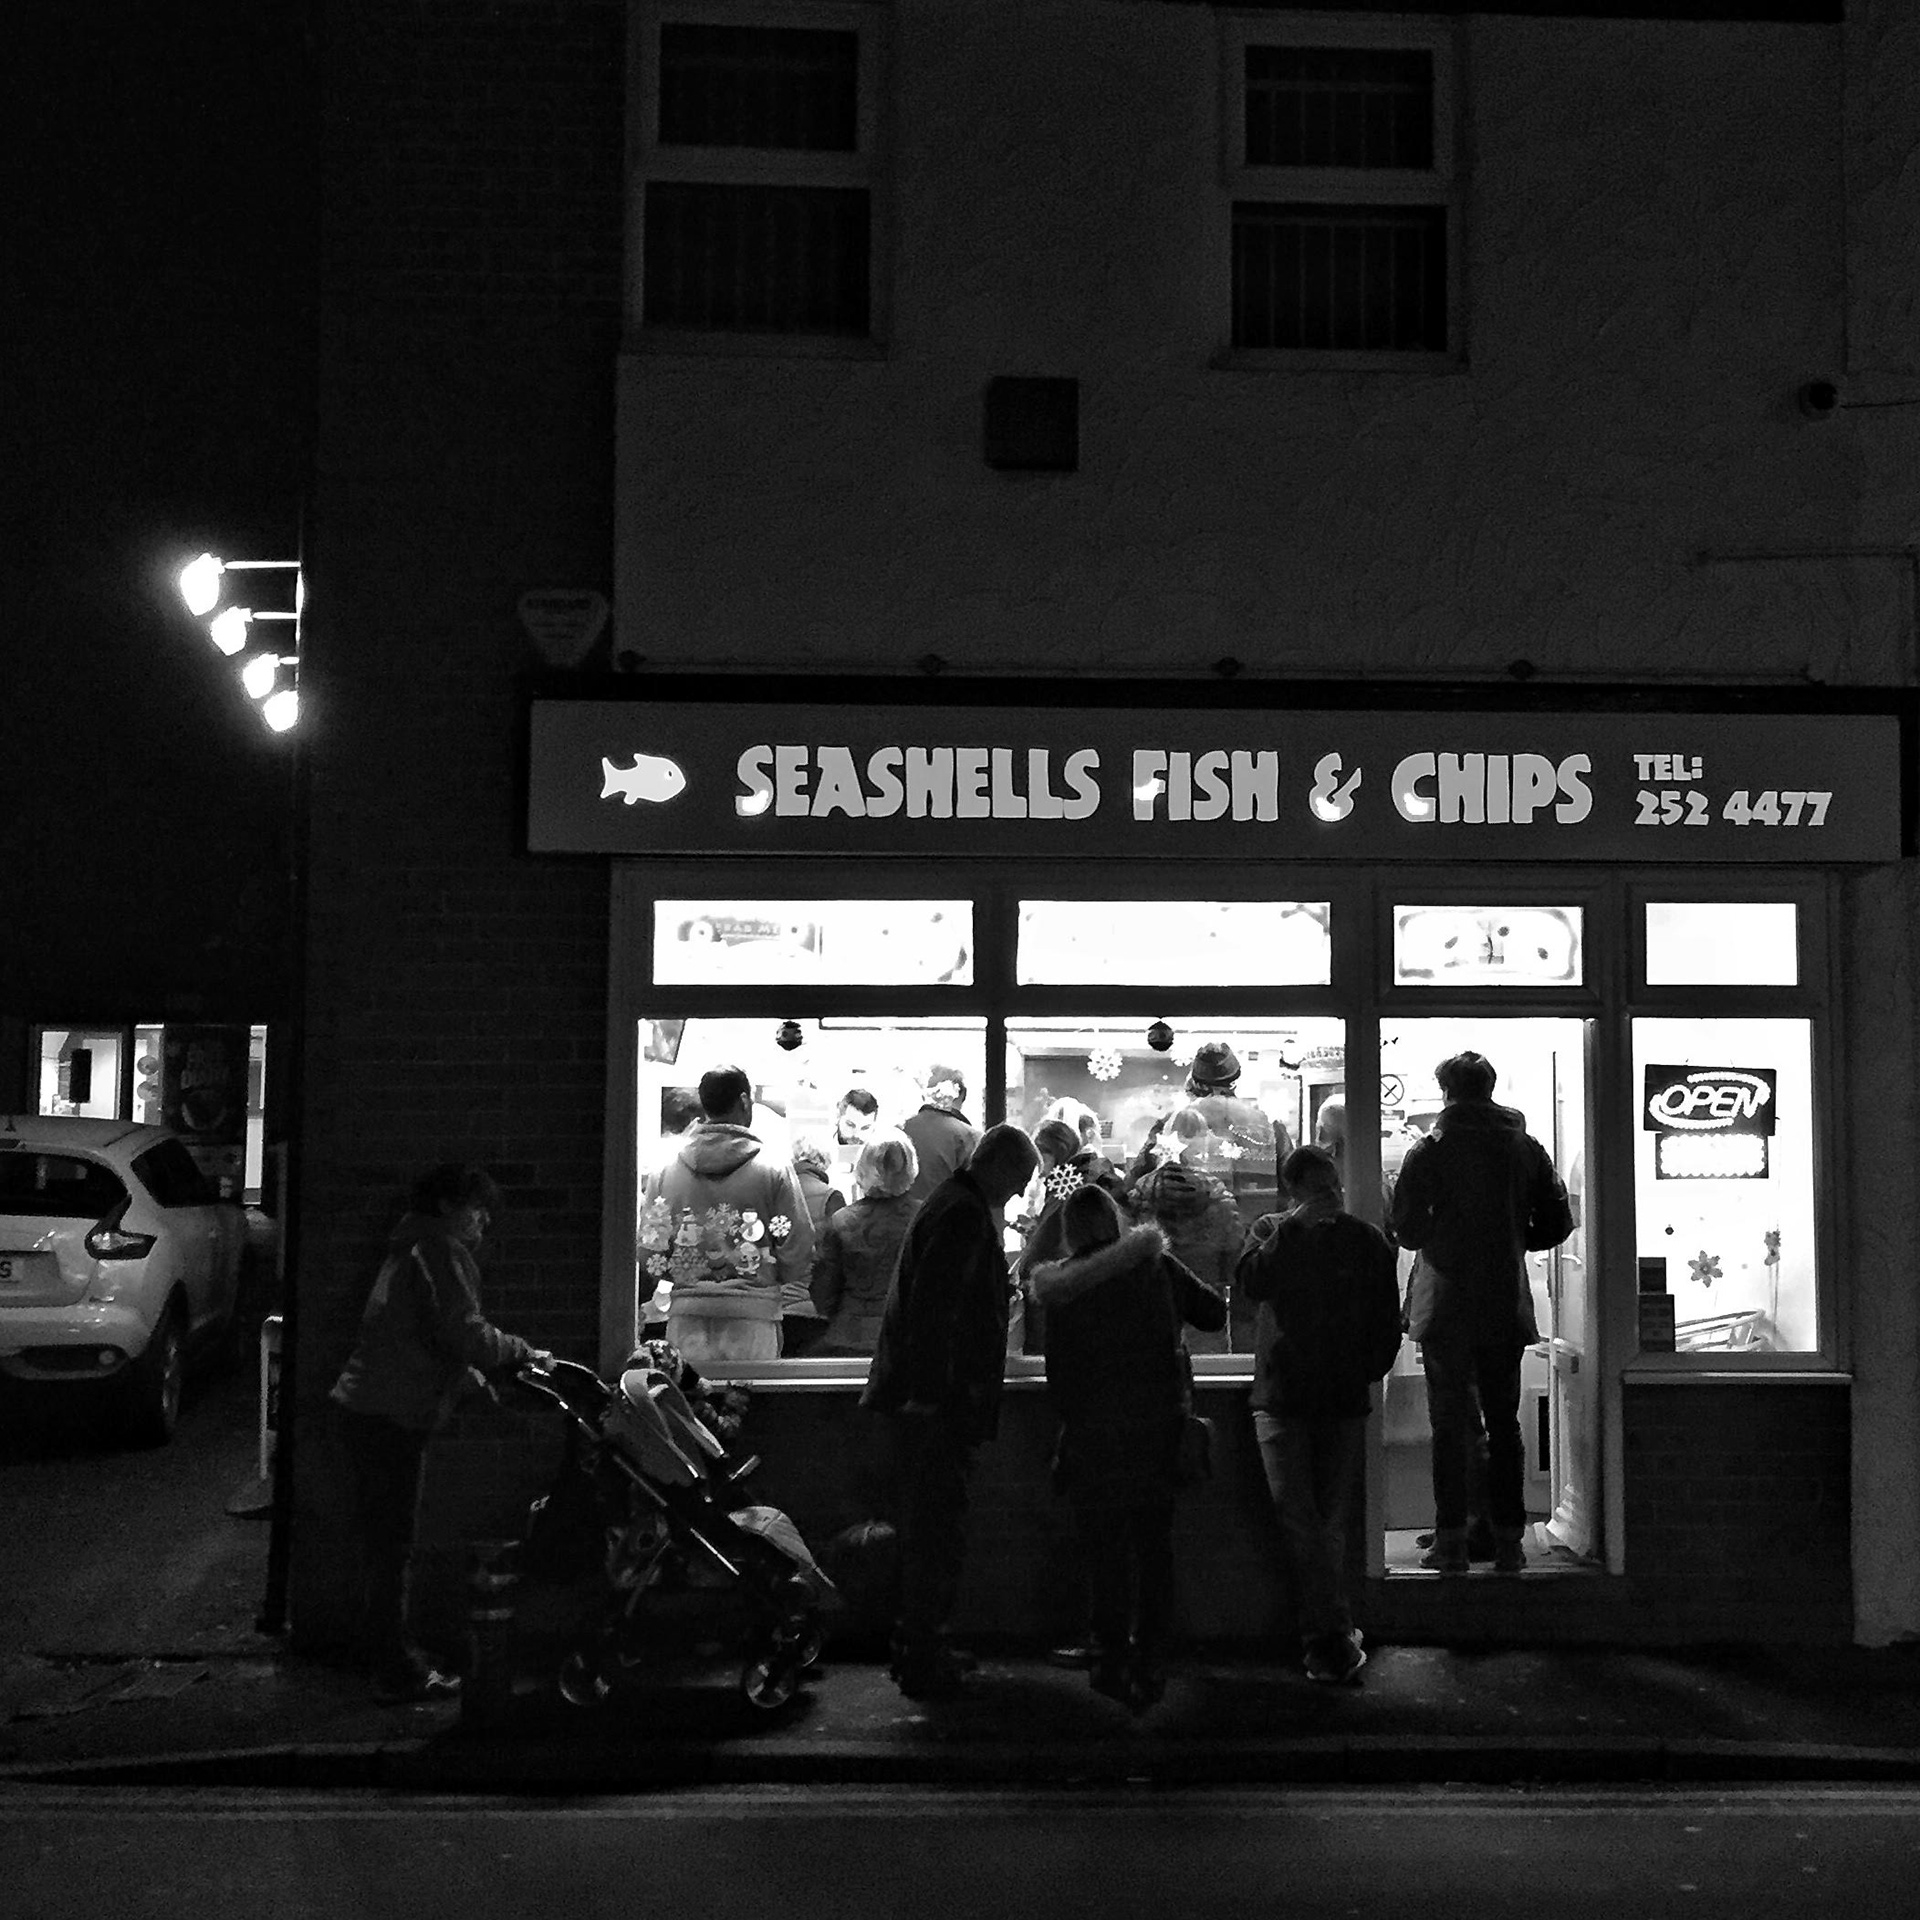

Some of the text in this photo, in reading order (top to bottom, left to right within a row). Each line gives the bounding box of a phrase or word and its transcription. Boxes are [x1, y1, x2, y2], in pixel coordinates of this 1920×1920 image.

[735, 745, 1592, 824] SEASHELLS FISH & CHIPS
[1634, 753, 1703, 781] TEL:
[1634, 789, 1833, 826] 252 4477
[1659, 1084, 1759, 1119] OPEN
